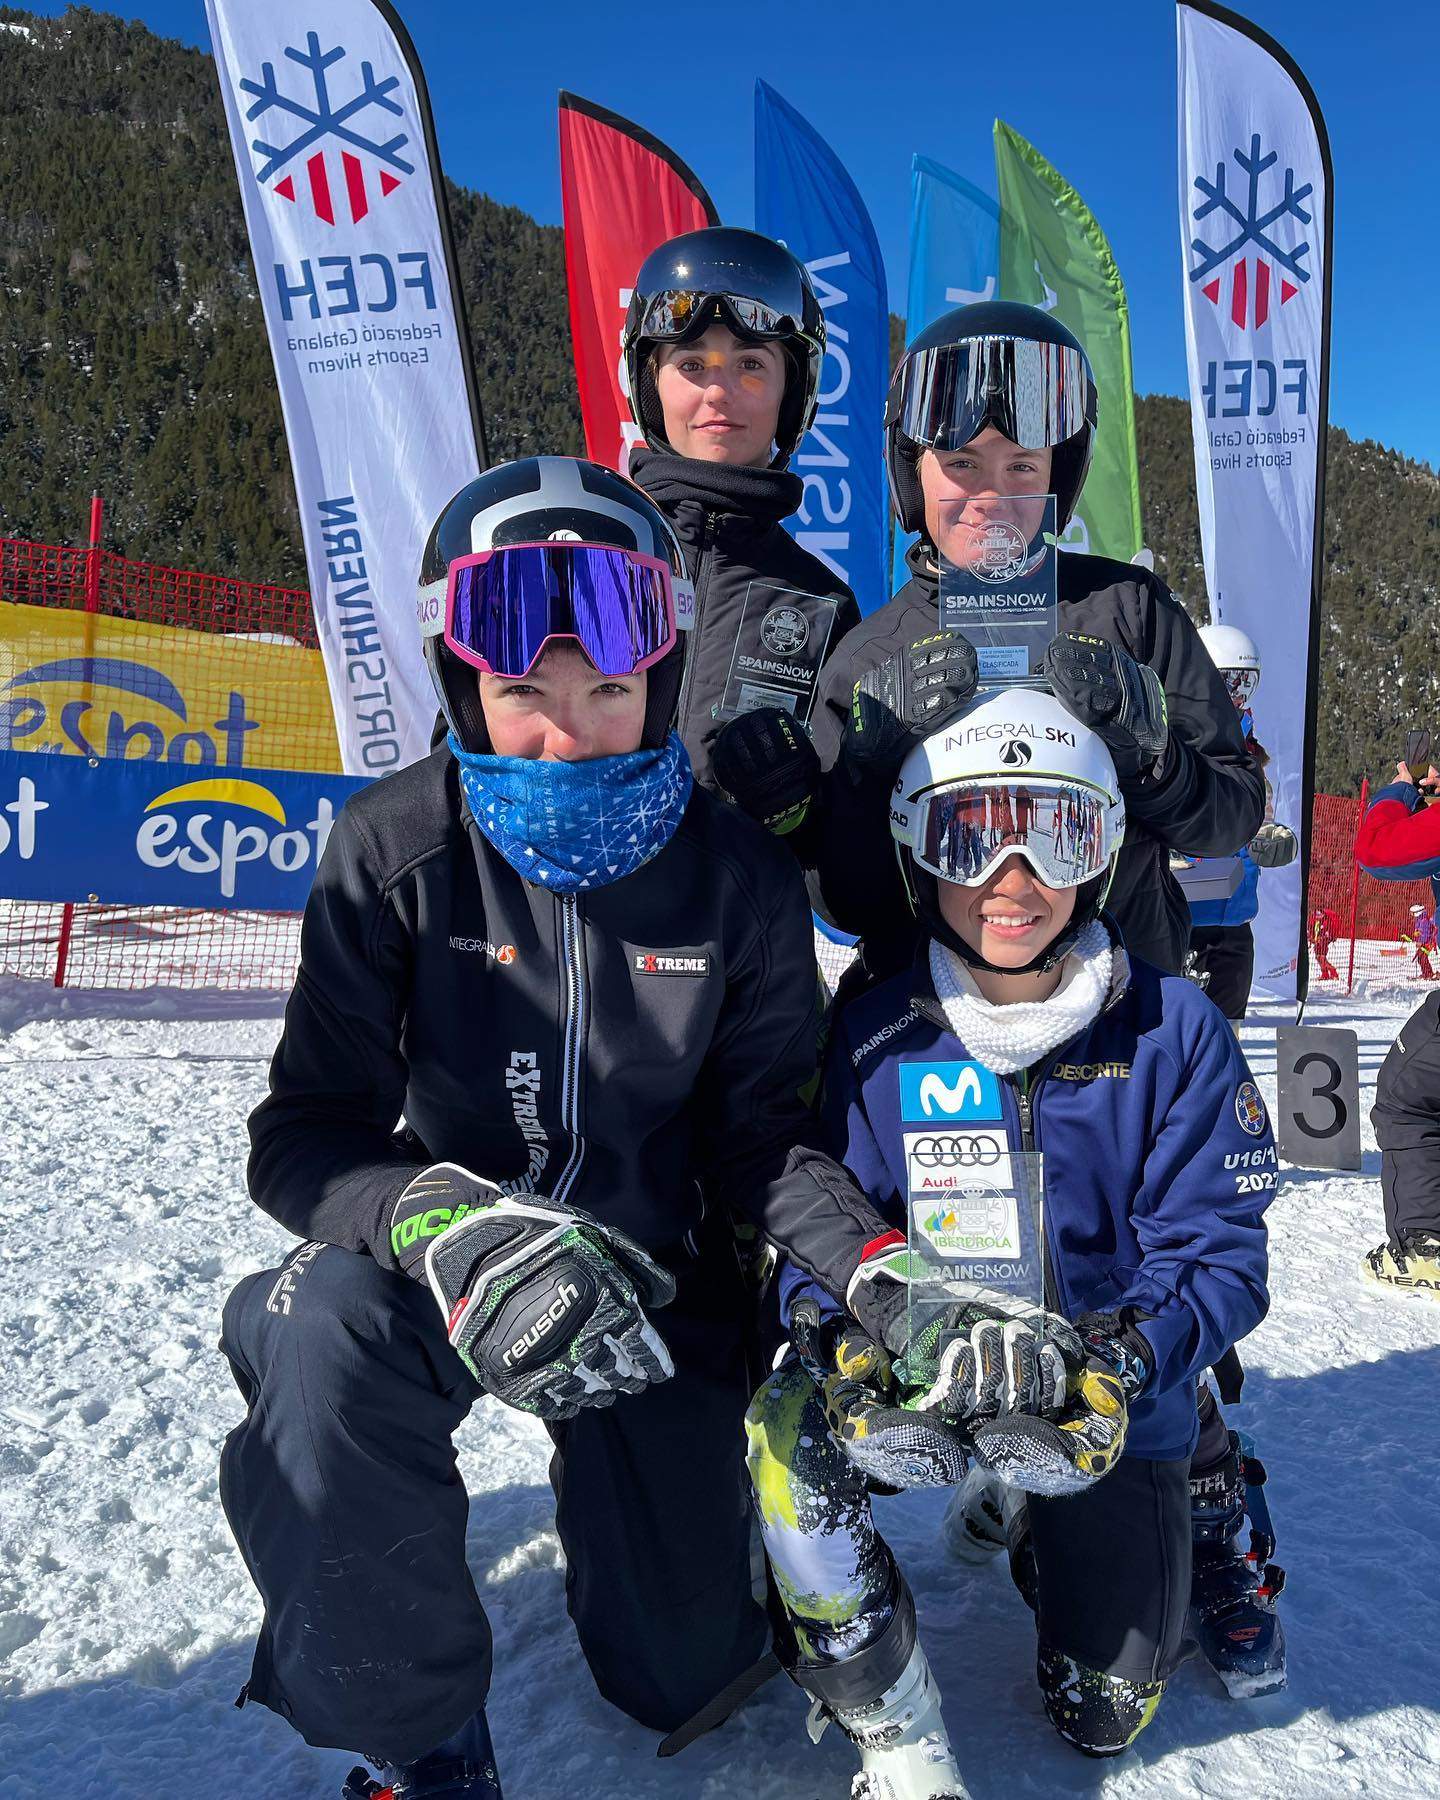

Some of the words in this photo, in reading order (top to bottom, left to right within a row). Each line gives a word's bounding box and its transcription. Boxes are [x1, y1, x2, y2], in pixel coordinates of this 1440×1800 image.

[946, 593, 1047, 609] SPAINSNOW
[738, 655, 815, 680] SPAINSNOW
[449, 936, 492, 954] NTEGRAL
[636, 954, 706, 972] EXTREME
[1052, 1062, 1131, 1081] DESCENTE
[1293, 1053, 1347, 1139] 3
[1224, 1146, 1277, 1170] U16/1
[922, 1176, 957, 1188] Audi
[935, 1236, 1012, 1249] IBERDROLA
[928, 1263, 1031, 1280] PAINSNOW
[502, 1283, 580, 1367] reusch
